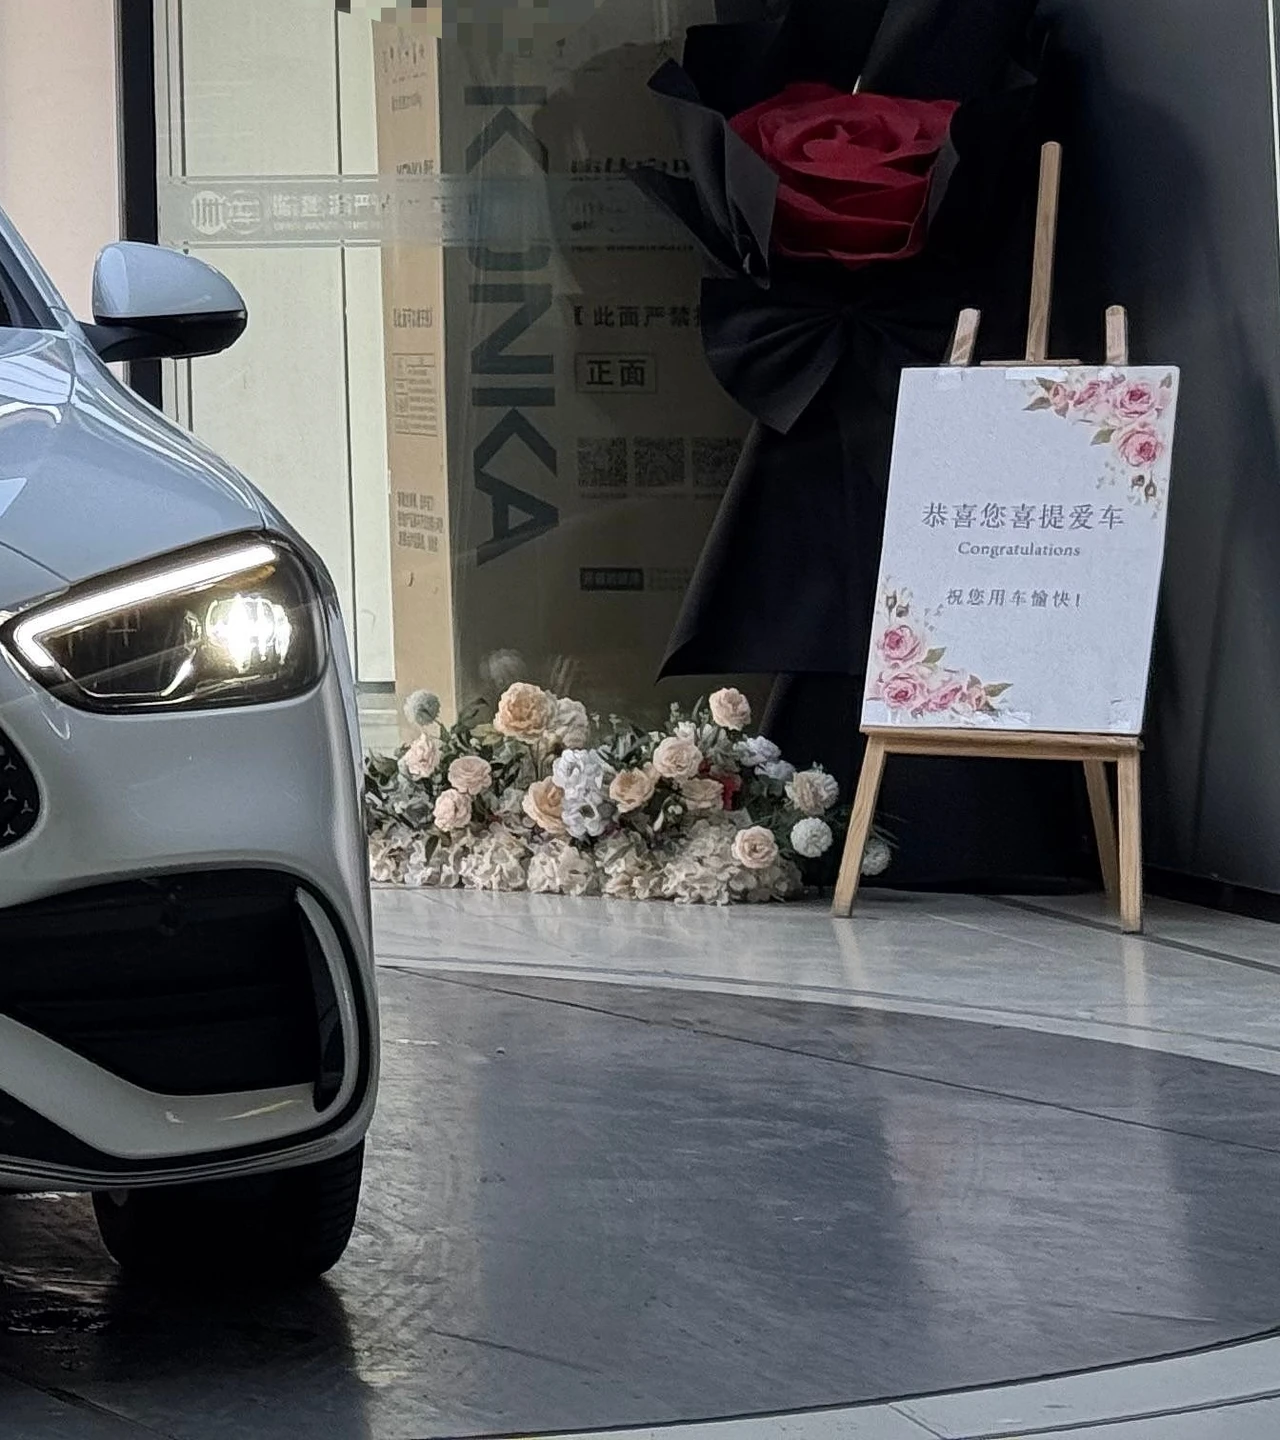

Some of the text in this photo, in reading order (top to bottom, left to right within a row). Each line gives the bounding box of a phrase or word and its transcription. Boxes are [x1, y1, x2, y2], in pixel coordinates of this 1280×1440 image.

[573, 305, 700, 328] 【此面严禁
[586, 359, 646, 387] 正面
[922, 502, 1125, 530] 恭喜您喜提爱车
[957, 541, 1081, 559] Congratulations
